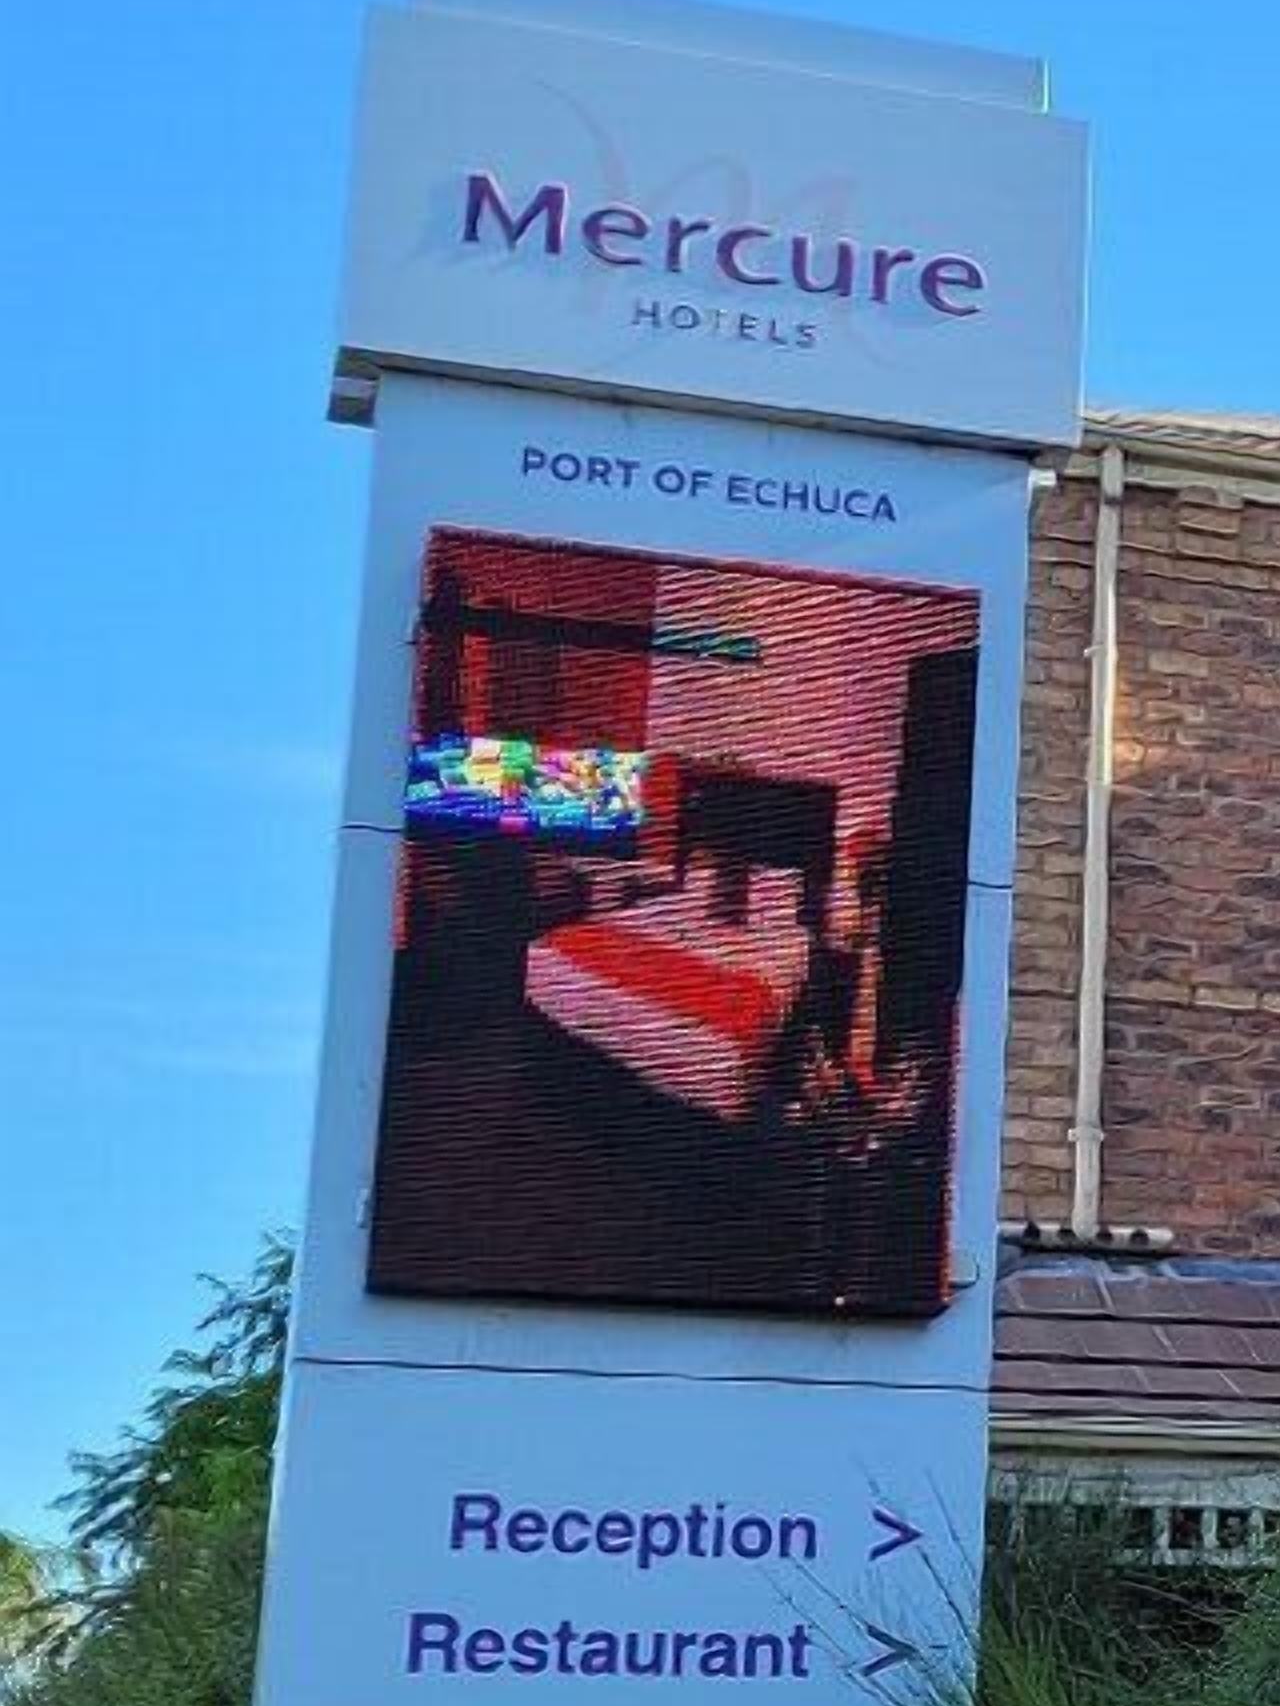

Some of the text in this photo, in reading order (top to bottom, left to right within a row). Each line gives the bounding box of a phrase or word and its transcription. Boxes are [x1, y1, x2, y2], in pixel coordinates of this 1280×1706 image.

[462, 168, 986, 318] Mercure
[632, 297, 818, 348] HOTELS
[519, 446, 897, 523] PORT OF ECHUCA
[449, 1494, 818, 1568] Reception
[406, 1612, 812, 1678] Restaurant
